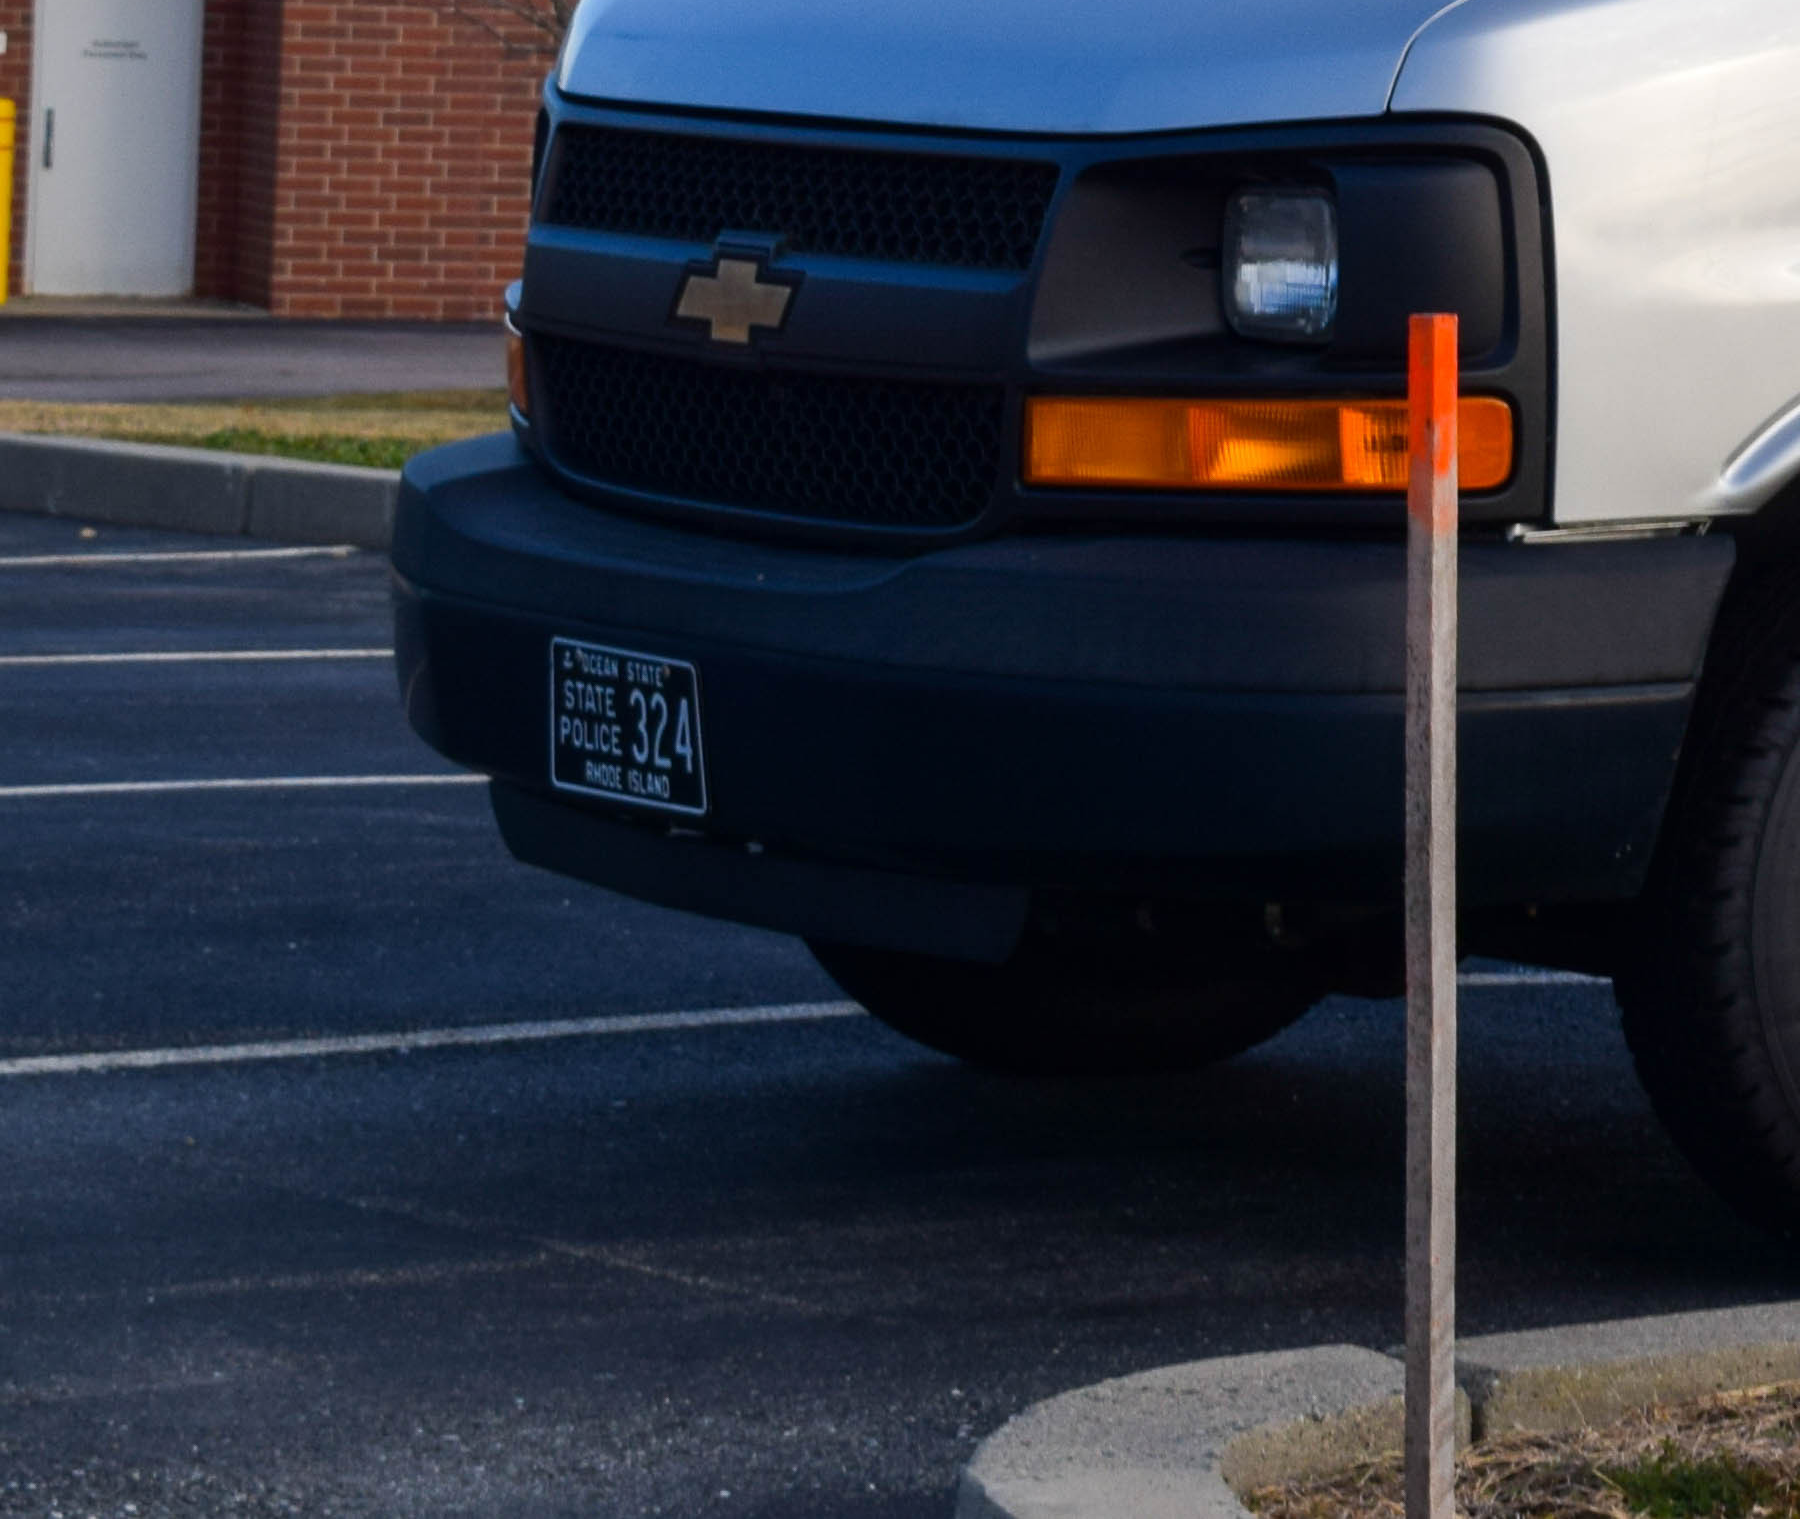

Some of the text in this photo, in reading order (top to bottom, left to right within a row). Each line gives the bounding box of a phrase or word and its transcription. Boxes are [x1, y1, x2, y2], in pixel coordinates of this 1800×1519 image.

[582, 653, 664, 687] OCEAN STATE
[564, 680, 617, 718] STATE
[560, 716, 622, 755] POLICE
[630, 689, 693, 773] 324
[585, 760, 670, 799] RHODE ISLAND
